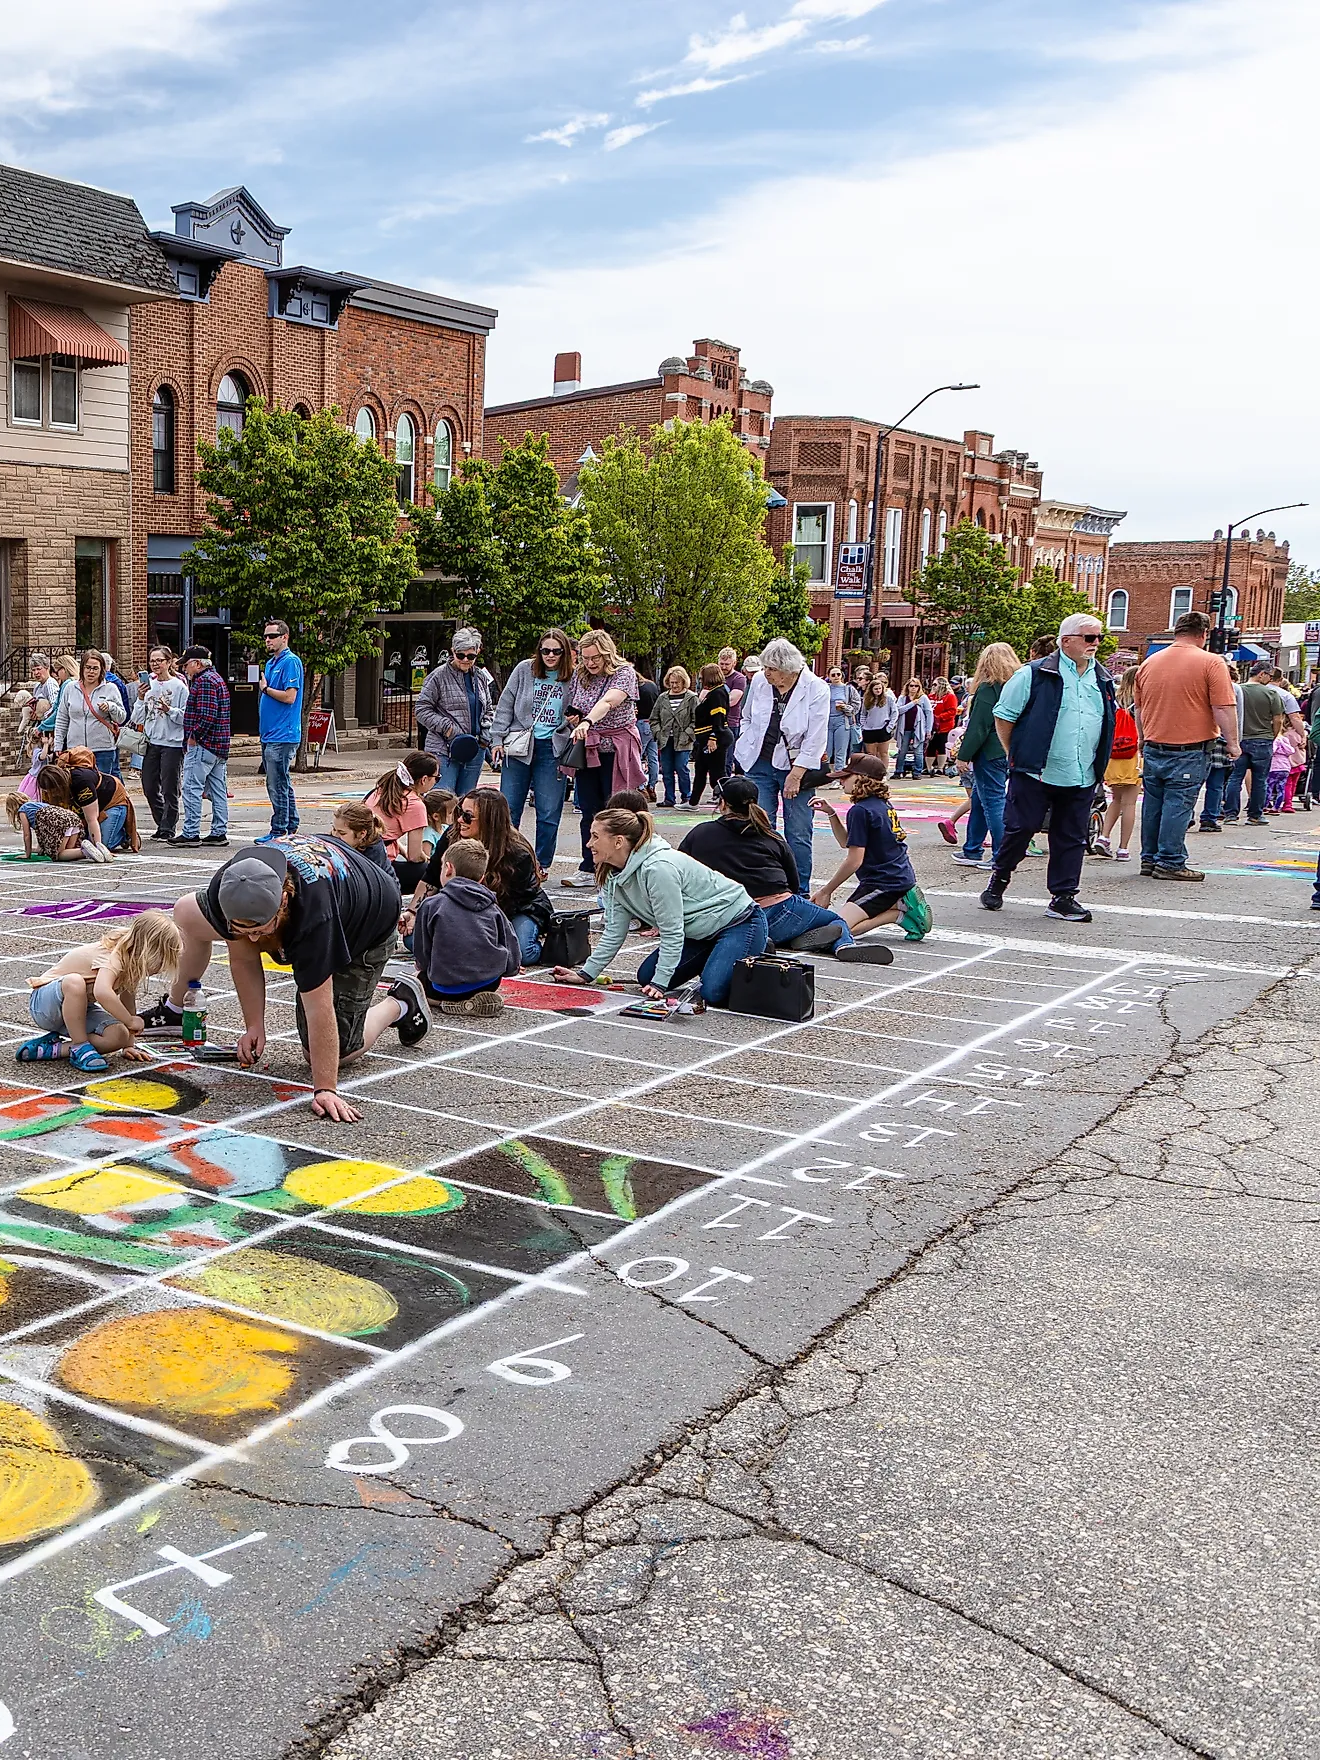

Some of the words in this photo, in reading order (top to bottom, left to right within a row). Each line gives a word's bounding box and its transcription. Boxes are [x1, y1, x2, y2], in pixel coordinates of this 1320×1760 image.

[1134, 968, 1209, 982] 20
[1101, 983, 1176, 998] 19
[1074, 995, 1153, 1014] 18
[1043, 1017, 1127, 1034] 17
[1014, 1038, 1095, 1058] 16
[964, 1062, 1057, 1086] 15
[902, 1089, 1027, 1116] 14
[858, 1122, 958, 1148] 13
[791, 1157, 906, 1190] 12
[701, 1193, 835, 1241] 11
[616, 1255, 754, 1303] 10
[323, 1403, 464, 1475] 8
[92, 1531, 268, 1638] 7
